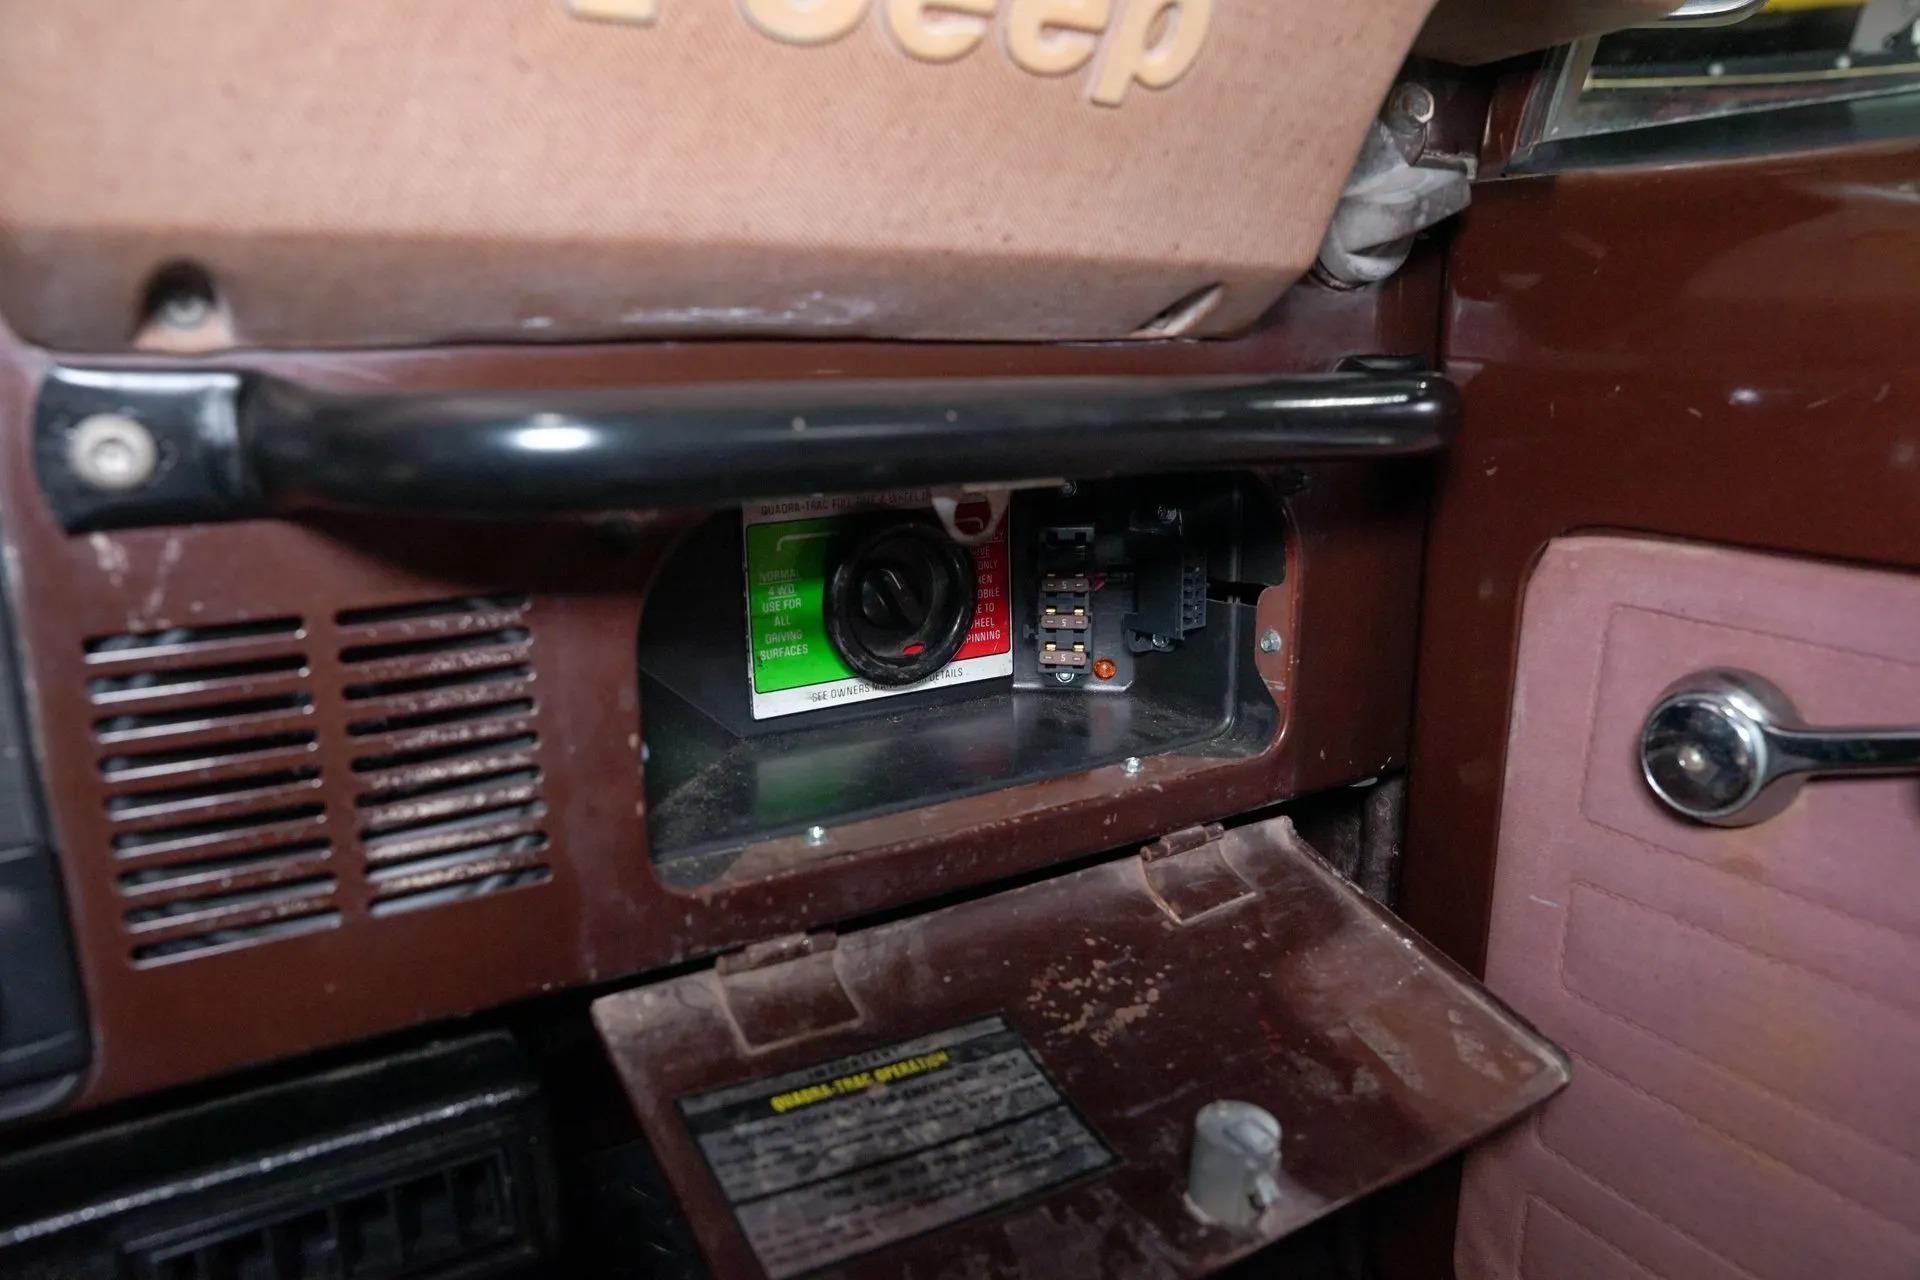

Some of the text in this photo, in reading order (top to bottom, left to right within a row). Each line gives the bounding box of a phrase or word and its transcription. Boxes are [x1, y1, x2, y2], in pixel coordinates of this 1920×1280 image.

[977, 587, 1001, 600] OBILE
[761, 597, 802, 613] USE FOR
[985, 602, 995, 613] TO
[774, 615, 791, 627] ALL
[971, 616, 995, 629] HEEL
[764, 629, 802, 645] DRIVING
[966, 630, 1001, 645] PINNING
[759, 645, 809, 661] SURFACES
[810, 690, 829, 703] SEE
[830, 682, 871, 699] OWNERS
